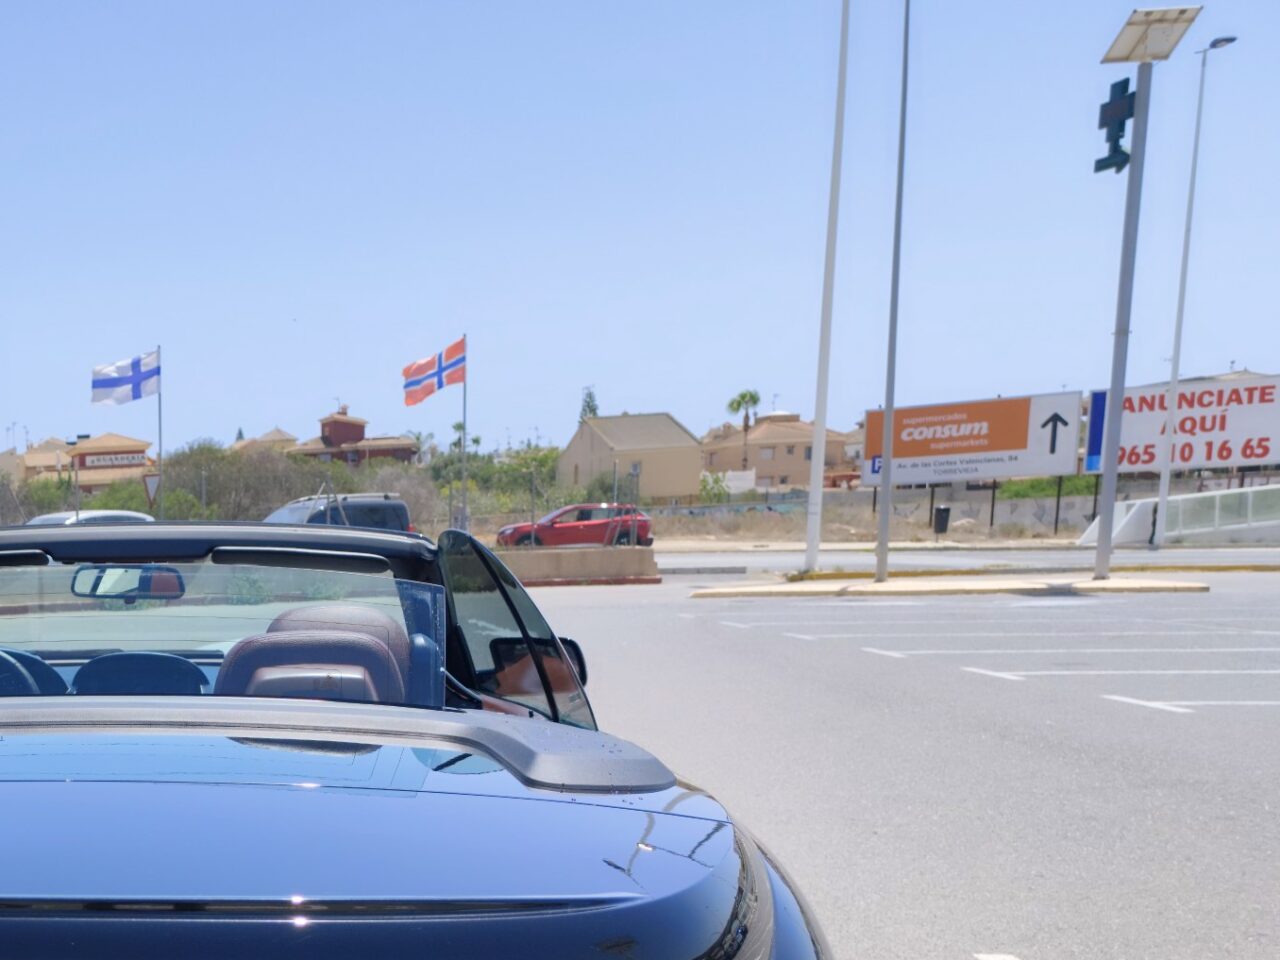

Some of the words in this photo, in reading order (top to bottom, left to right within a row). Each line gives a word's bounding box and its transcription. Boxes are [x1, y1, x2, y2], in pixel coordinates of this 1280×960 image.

[900, 421, 989, 442] consum
[1205, 440, 1232, 461] 16
[1241, 437, 1271, 459] 65
